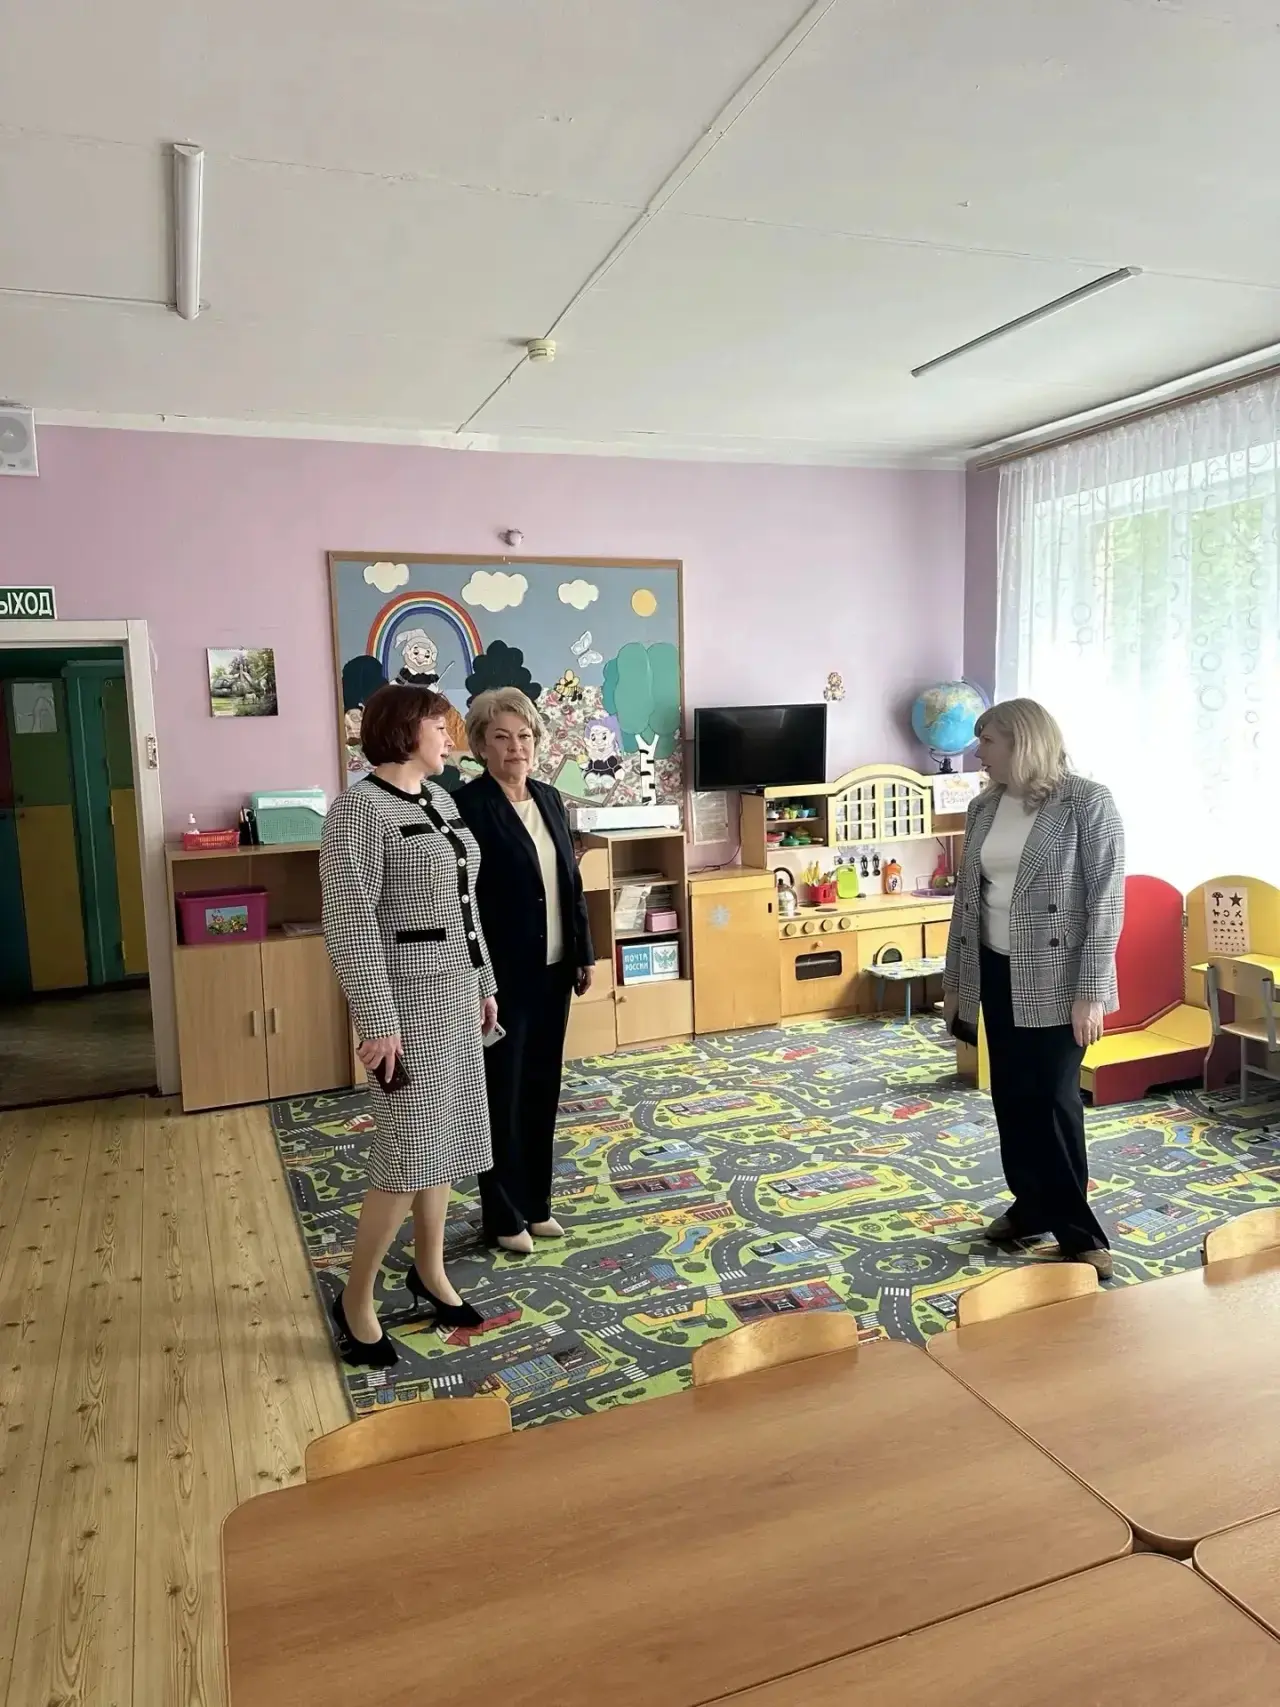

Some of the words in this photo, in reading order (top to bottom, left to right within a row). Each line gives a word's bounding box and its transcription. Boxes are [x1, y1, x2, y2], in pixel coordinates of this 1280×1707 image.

[624, 952, 648, 962] ПОЧТА
[625, 962, 648, 971] РОССИИ
[654, 1304, 688, 1317] BUS
